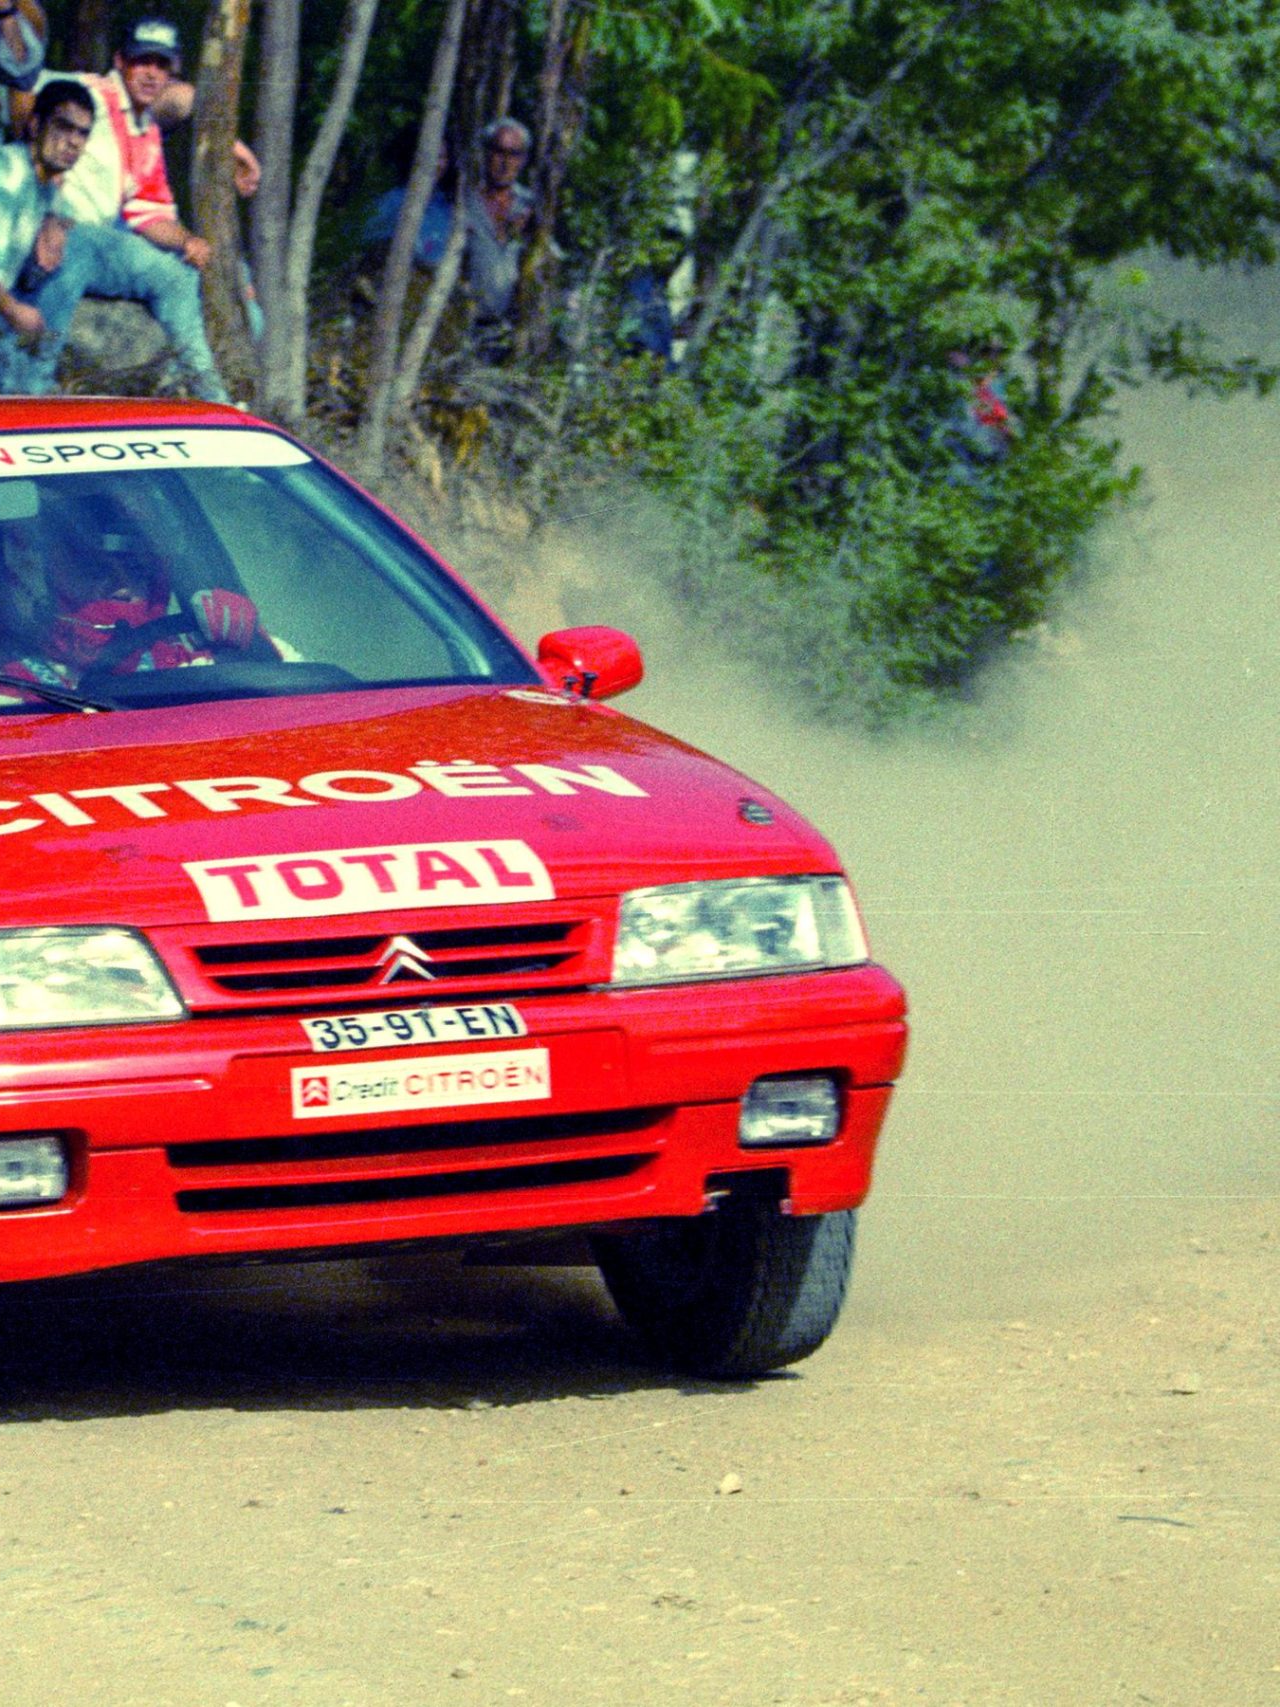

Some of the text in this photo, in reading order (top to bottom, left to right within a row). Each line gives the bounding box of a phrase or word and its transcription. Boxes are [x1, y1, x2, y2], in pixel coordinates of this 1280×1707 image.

[21, 441, 192, 465] SPORT
[204, 846, 539, 908] TOTAL
[311, 1005, 520, 1050] 35-91-EN
